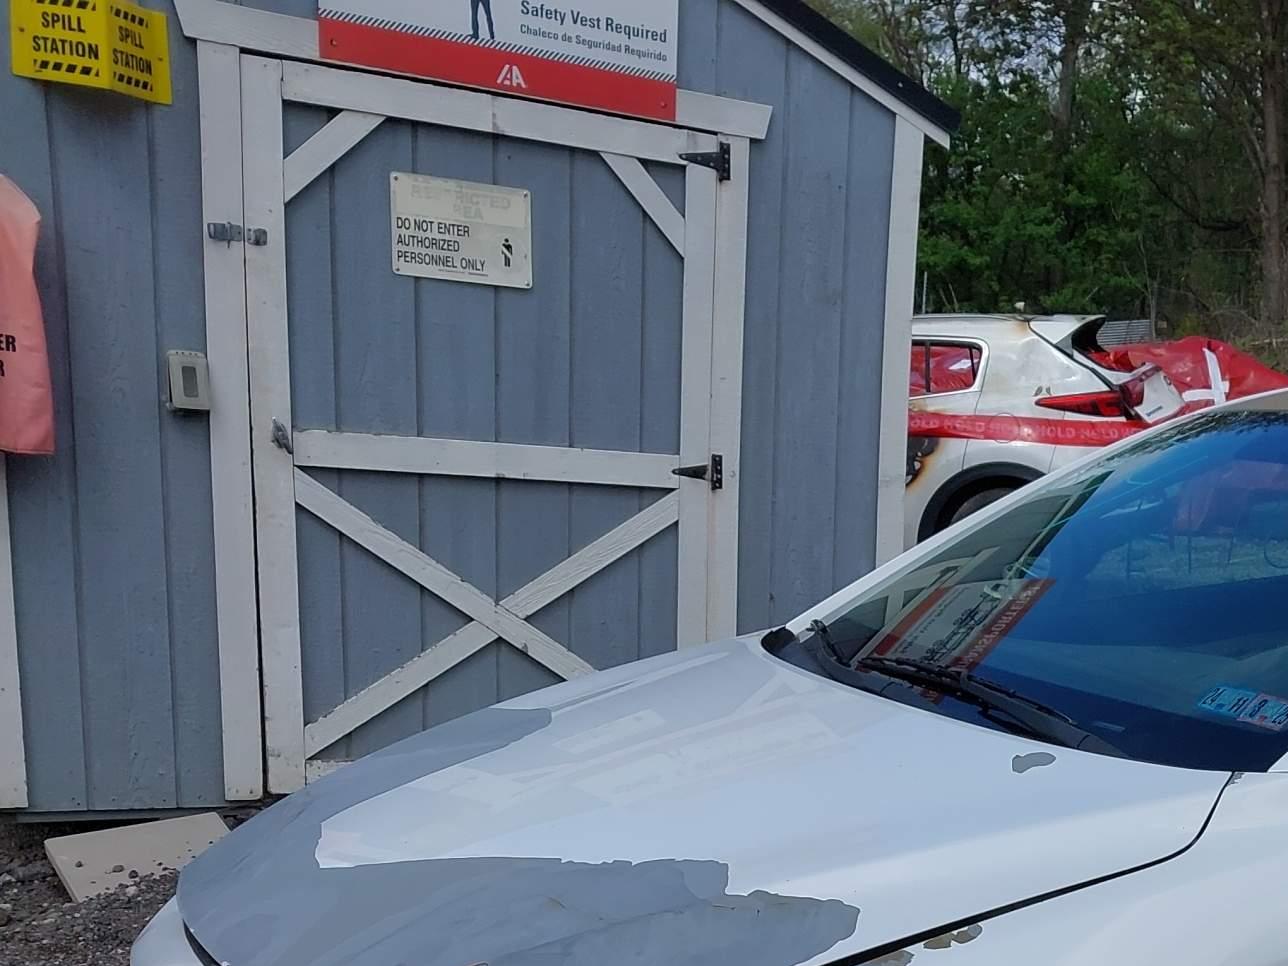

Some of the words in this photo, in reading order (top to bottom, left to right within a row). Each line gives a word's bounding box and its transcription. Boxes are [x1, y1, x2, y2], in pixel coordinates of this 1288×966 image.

[41, 11, 86, 33] SPILL
[521, 0, 566, 26] Safety
[571, 10, 601, 30] Vest
[606, 17, 667, 43] Required
[32, 35, 99, 60] STATION
[118, 26, 144, 49] SPILL
[520, 23, 559, 40] Chaleco
[561, 31, 573, 43] de
[575, 35, 622, 53] Seguridad
[624, 45, 667, 62] Requirido
[113, 47, 152, 75] STATION
[396, 216, 411, 230] DO
[414, 219, 434, 233] NOT
[437, 222, 470, 237] ENTER
[397, 234, 460, 252] AUTHORIZED
[397, 250, 457, 269] PERSONNEL
[460, 257, 486, 272] ONLY
